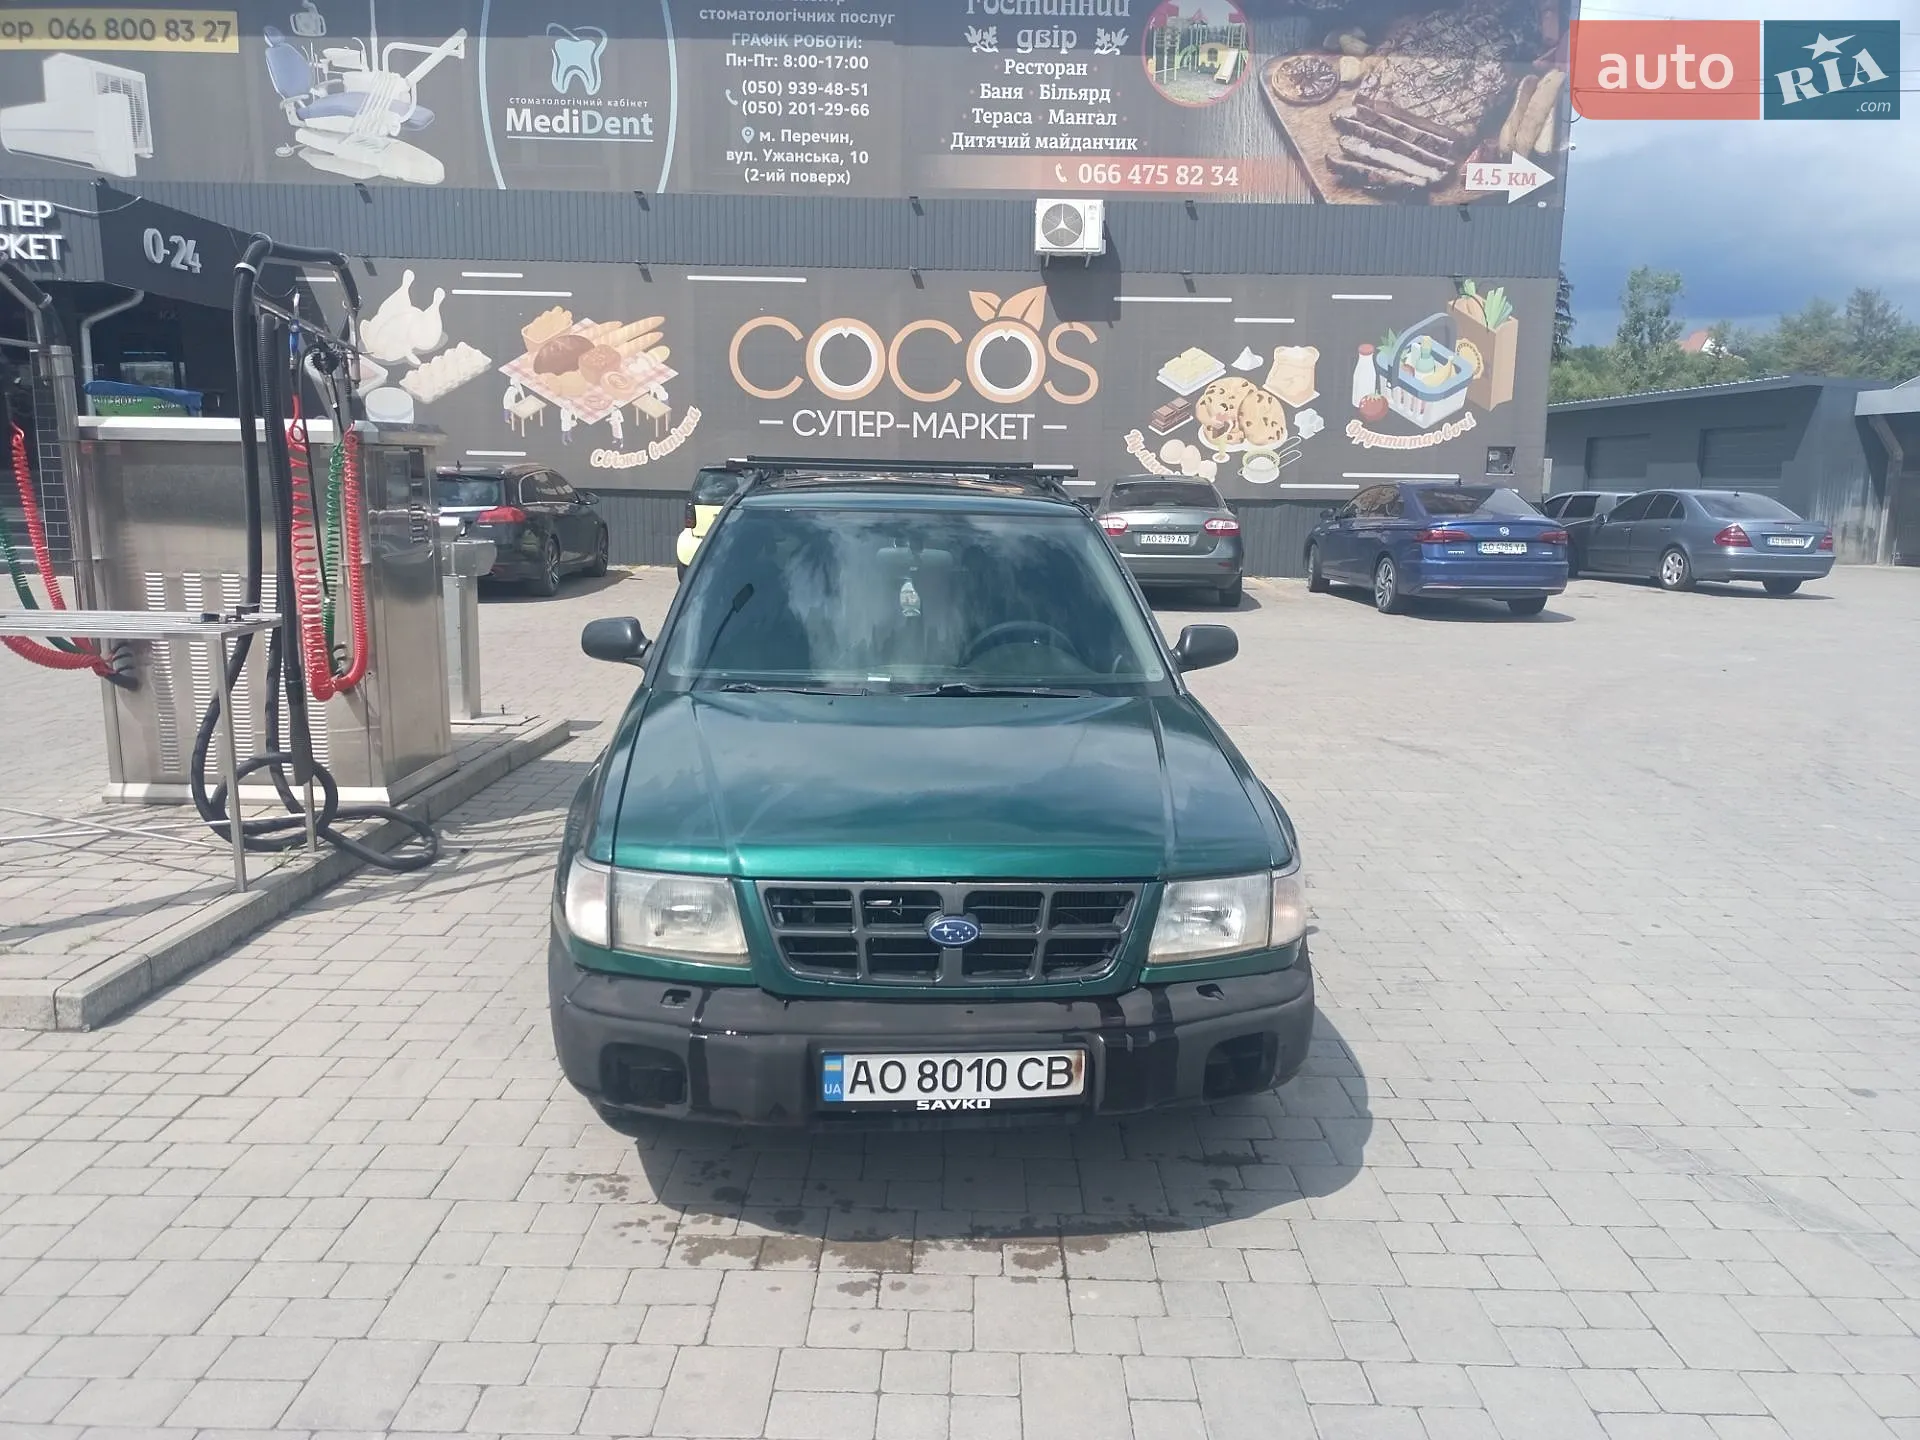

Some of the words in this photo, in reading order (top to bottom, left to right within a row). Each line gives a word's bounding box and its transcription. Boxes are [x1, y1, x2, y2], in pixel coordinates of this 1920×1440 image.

[699, 8, 836, 23] стоматологічних
[840, 12, 896, 27] послуг
[0, 21, 34, 43] ор
[48, 18, 97, 40] 066
[104, 18, 156, 41] 800
[164, 20, 195, 42] 83
[203, 20, 232, 43] 27
[731, 33, 789, 47] ГРАФІК
[794, 34, 863, 49] РОБОТИ:
[725, 53, 778, 68] Пн-Пт:
[783, 54, 869, 70] 8:00-17:00
[1003, 58, 1089, 80] Ресторан
[742, 80, 783, 96] (050)
[788, 82, 868, 97] 939-48-51
[979, 83, 1024, 100] Баня
[1039, 84, 1111, 104] Більярд
[508, 97, 603, 107] стоматологічний
[607, 98, 649, 108] кабінет
[742, 100, 783, 116] (050)
[788, 102, 870, 117] 201-29-66
[506, 107, 654, 136] MediDent
[972, 107, 1033, 128] Тераса
[1048, 109, 1118, 126] Мангал
[759, 131, 776, 143] м.
[781, 129, 854, 146] Перечин,
[950, 131, 1031, 150] Дитячий
[1035, 133, 1139, 152] майданчик
[726, 151, 758, 165] вул.
[763, 148, 845, 166] Ужанська,
[850, 150, 869, 164] 10
[744, 167, 786, 183] (2-ий
[790, 169, 851, 186] поверх)
[1078, 163, 1122, 184] 066
[1127, 164, 1169, 186] 475
[1175, 165, 1204, 186] 82
[1210, 166, 1239, 187] 34
[1472, 167, 1502, 186] 4.5
[143, 227, 202, 274] 0-24
[729, 315, 1099, 405] COCOS
[792, 409, 1036, 441] СУПЕР-МАРКЕТ
[849, 1060, 906, 1094] AO
[917, 1058, 1007, 1094] 8010
[1017, 1056, 1075, 1091] CB
[824, 1084, 842, 1095] UA
[916, 1098, 991, 1110] SAVKO
